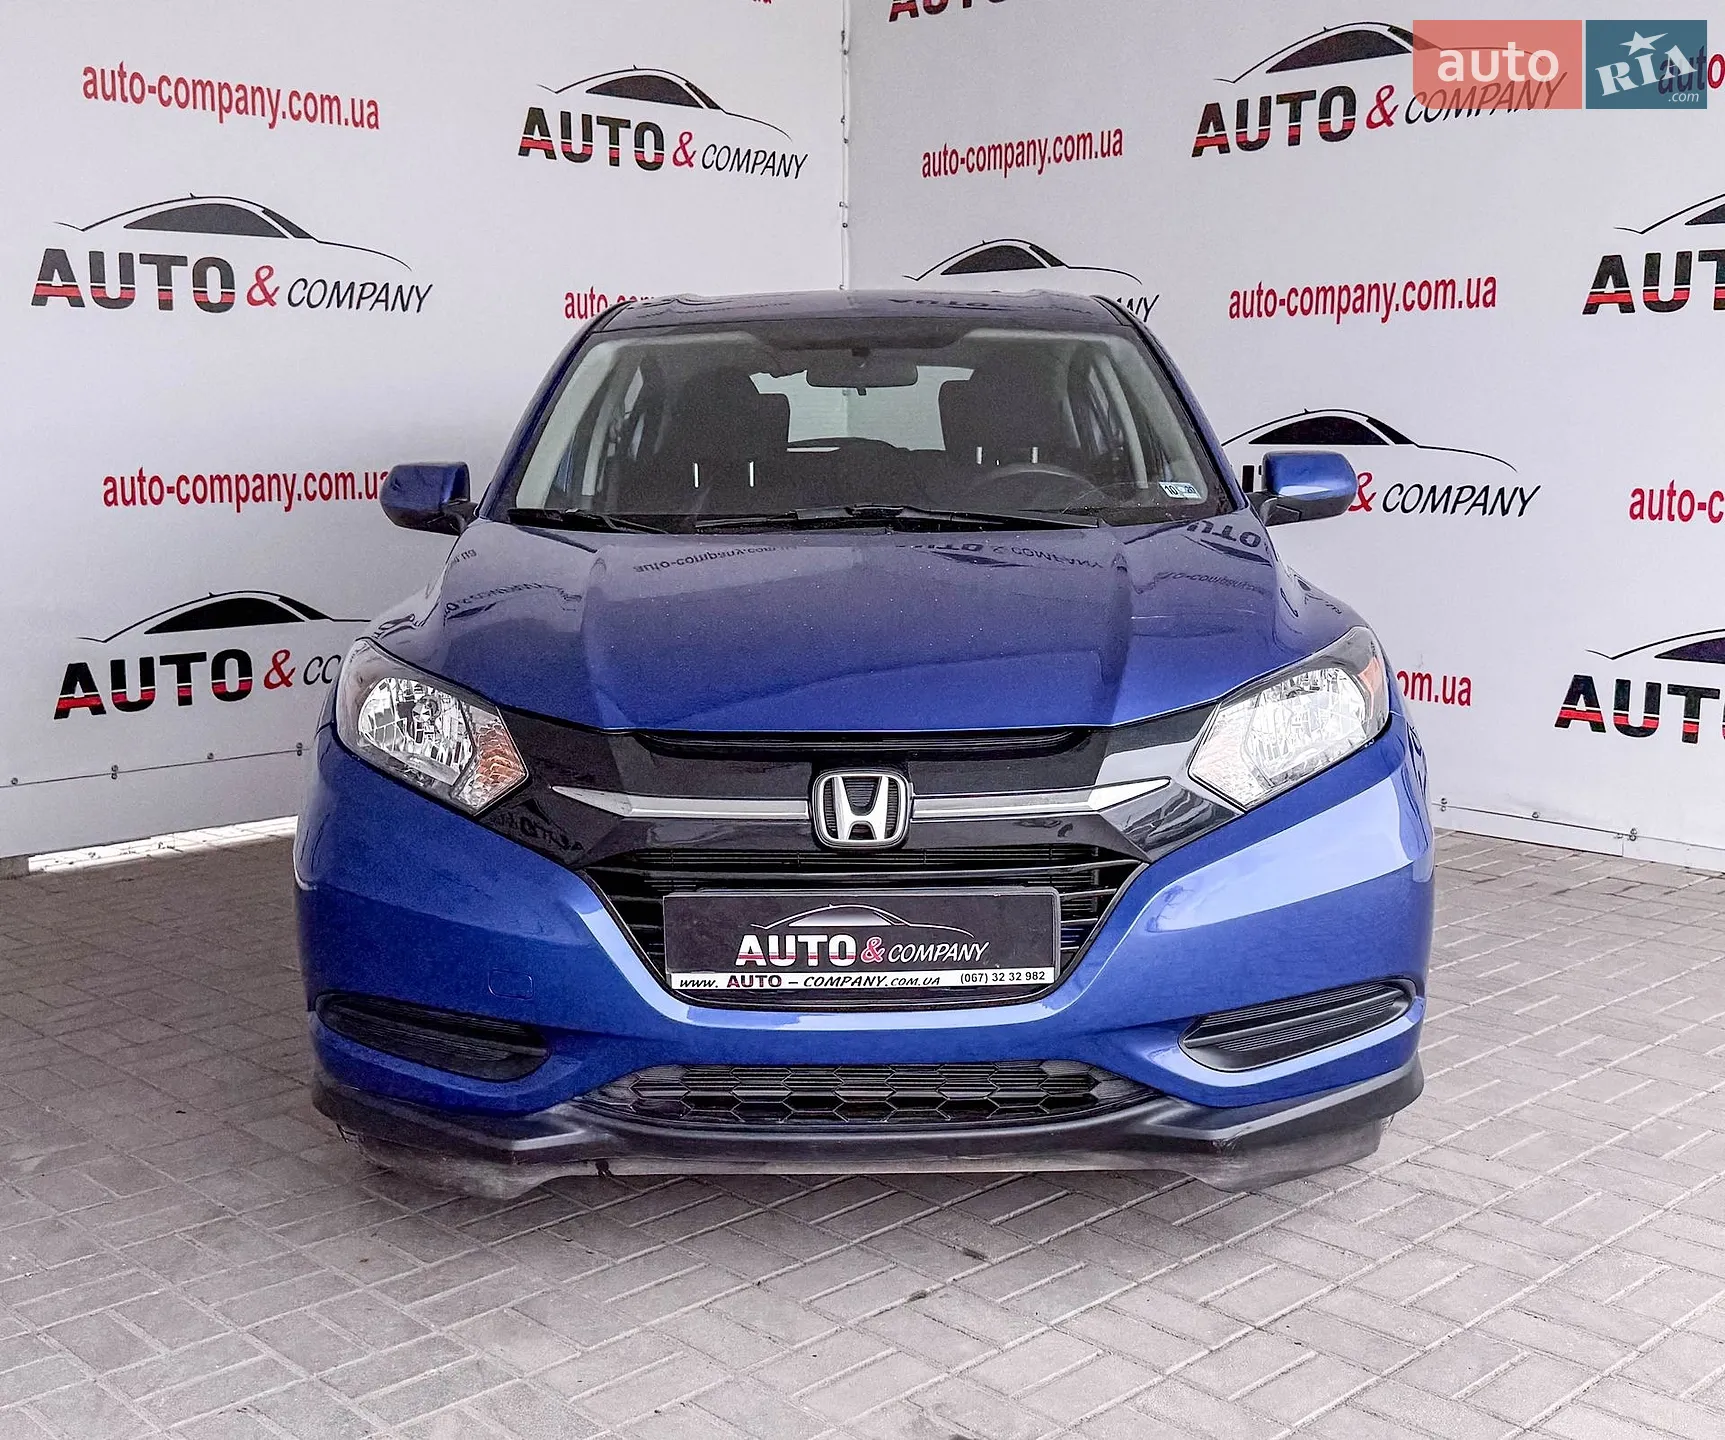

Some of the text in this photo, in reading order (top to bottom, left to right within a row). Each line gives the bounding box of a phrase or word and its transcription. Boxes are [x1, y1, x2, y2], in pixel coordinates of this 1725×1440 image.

[83, 61, 380, 129] auto-company.com.ua
[1191, 72, 1568, 158] AUTO & COMPANY
[518, 106, 809, 180] AUTO & COMPANY
[922, 128, 1123, 179] auto-company.com.ua
[31, 248, 434, 314] AUTO & COMPANY
[1228, 274, 1497, 325] auto-company.com.ua
[103, 467, 389, 513] auto-company.com.u
[1382, 482, 1542, 517] COMPANY
[1629, 479, 1725, 523] auto-c
[54, 648, 253, 720] AUTO
[263, 648, 296, 690] &
[1554, 674, 1725, 745] AUT
[735, 934, 991, 967] AUTO & COMPANY
[726, 974, 783, 989] AUTO
[960, 972, 989, 985] (067)
[991, 971, 1007, 983] 32
[1008, 971, 1022, 983] 32
[1024, 970, 1046, 982] 982
